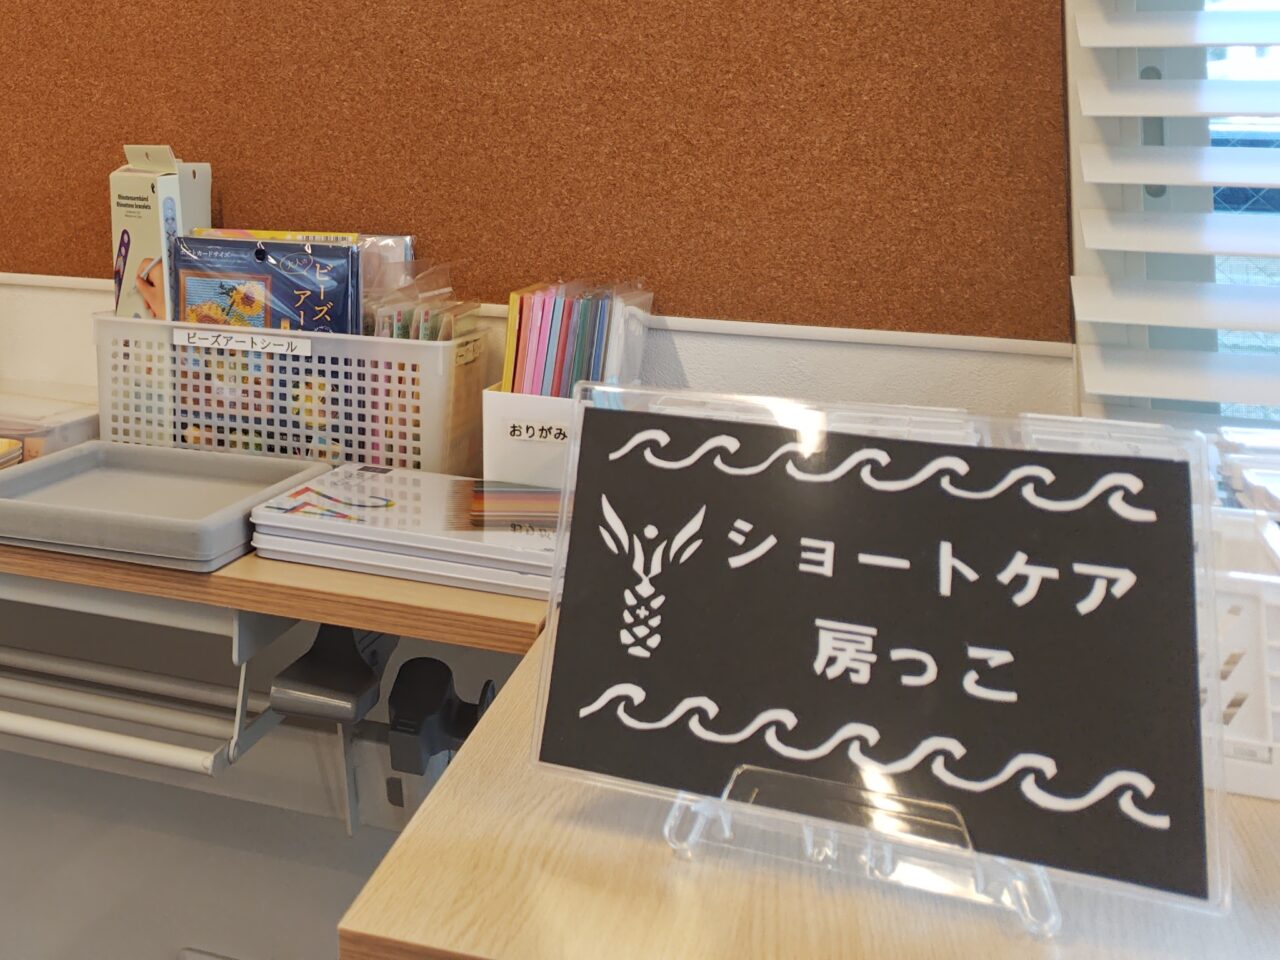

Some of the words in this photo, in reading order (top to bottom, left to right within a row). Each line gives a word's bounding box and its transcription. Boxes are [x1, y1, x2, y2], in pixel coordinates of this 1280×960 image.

[293, 289, 312, 331] アー
[313, 262, 333, 321] ビーズ
[187, 332, 298, 353] ビーズアートシール
[509, 423, 568, 441] おりがみ
[725, 518, 1138, 616] ショートケア
[813, 618, 1019, 702] 房っこ
